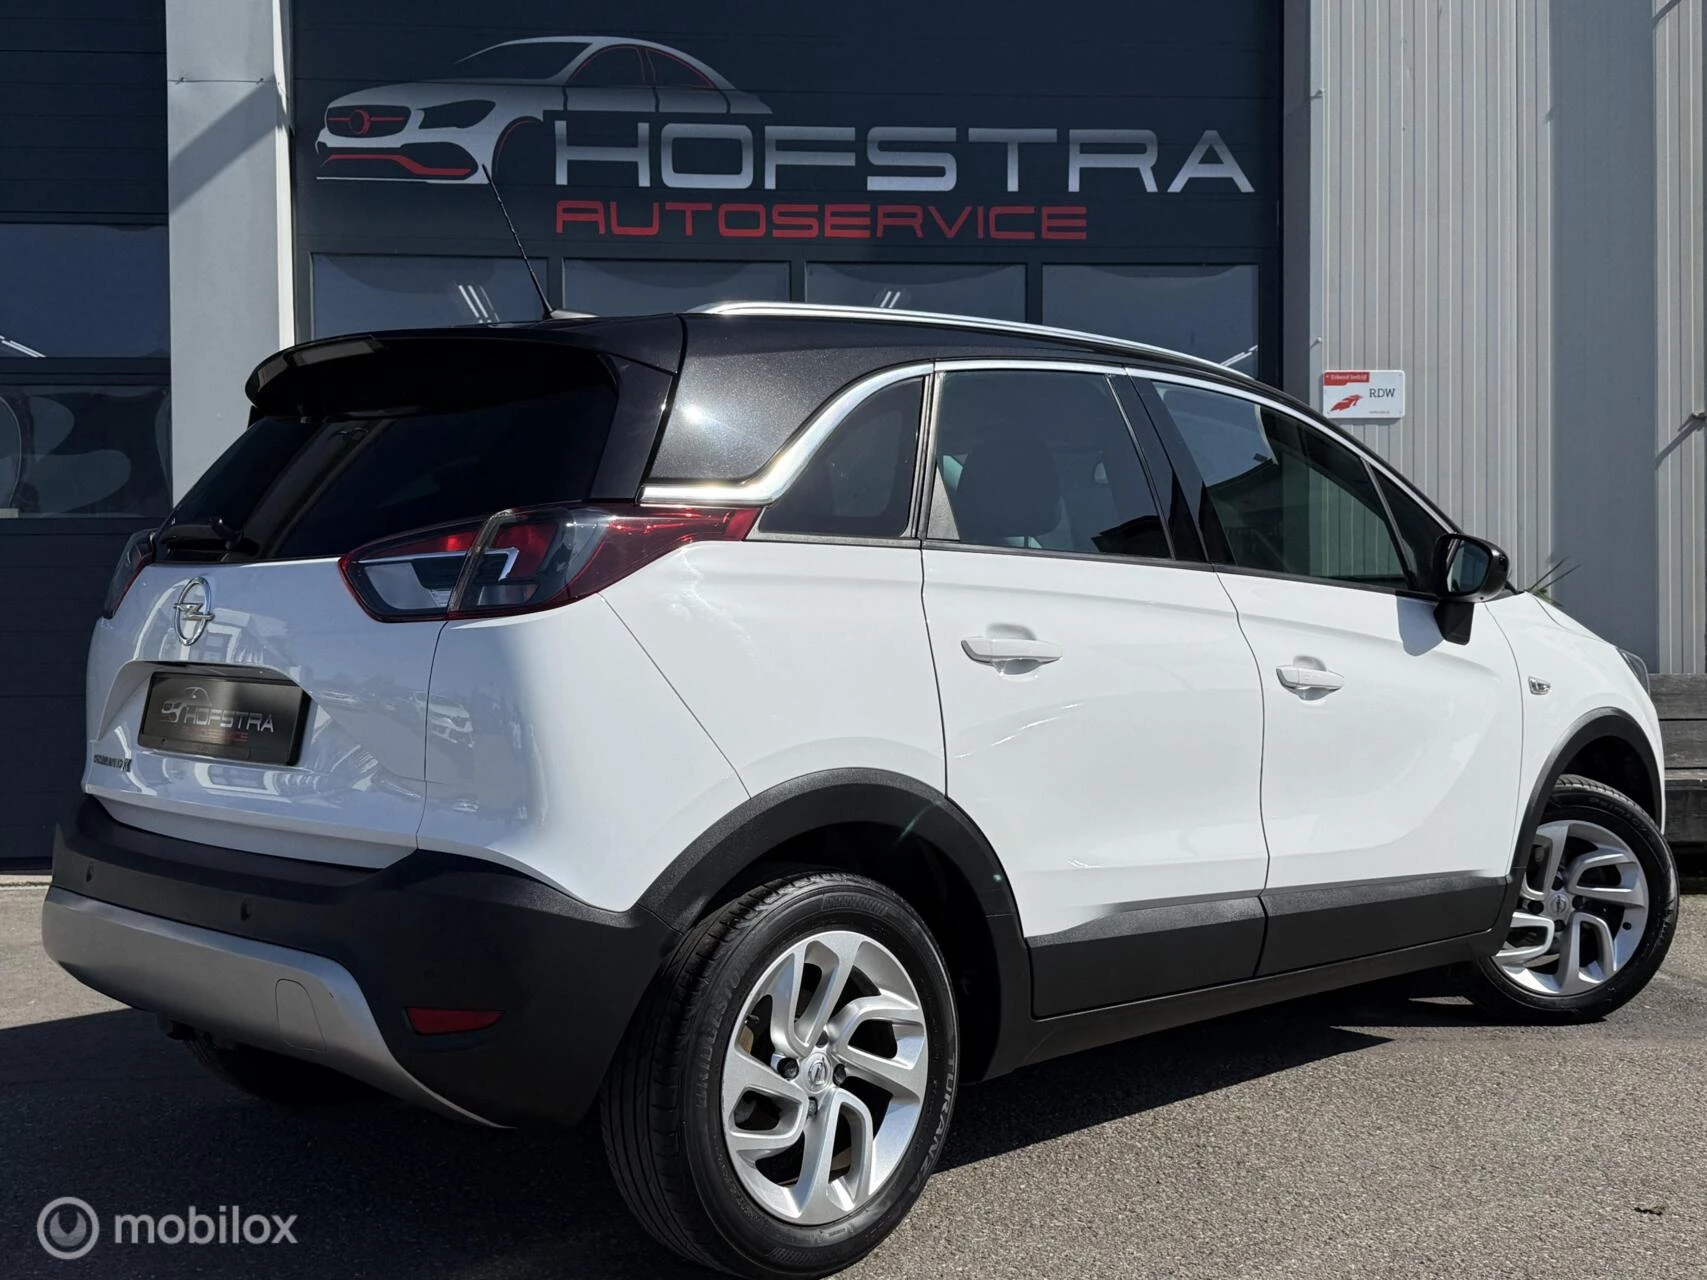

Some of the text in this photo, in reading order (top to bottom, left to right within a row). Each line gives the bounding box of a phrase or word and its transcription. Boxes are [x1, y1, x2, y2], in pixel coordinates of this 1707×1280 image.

[555, 119, 1255, 194] HOFSTRA
[555, 201, 1088, 240] AUTOSERVICE
[1369, 388, 1395, 397] RDW
[183, 705, 274, 732] HOFSTRA
